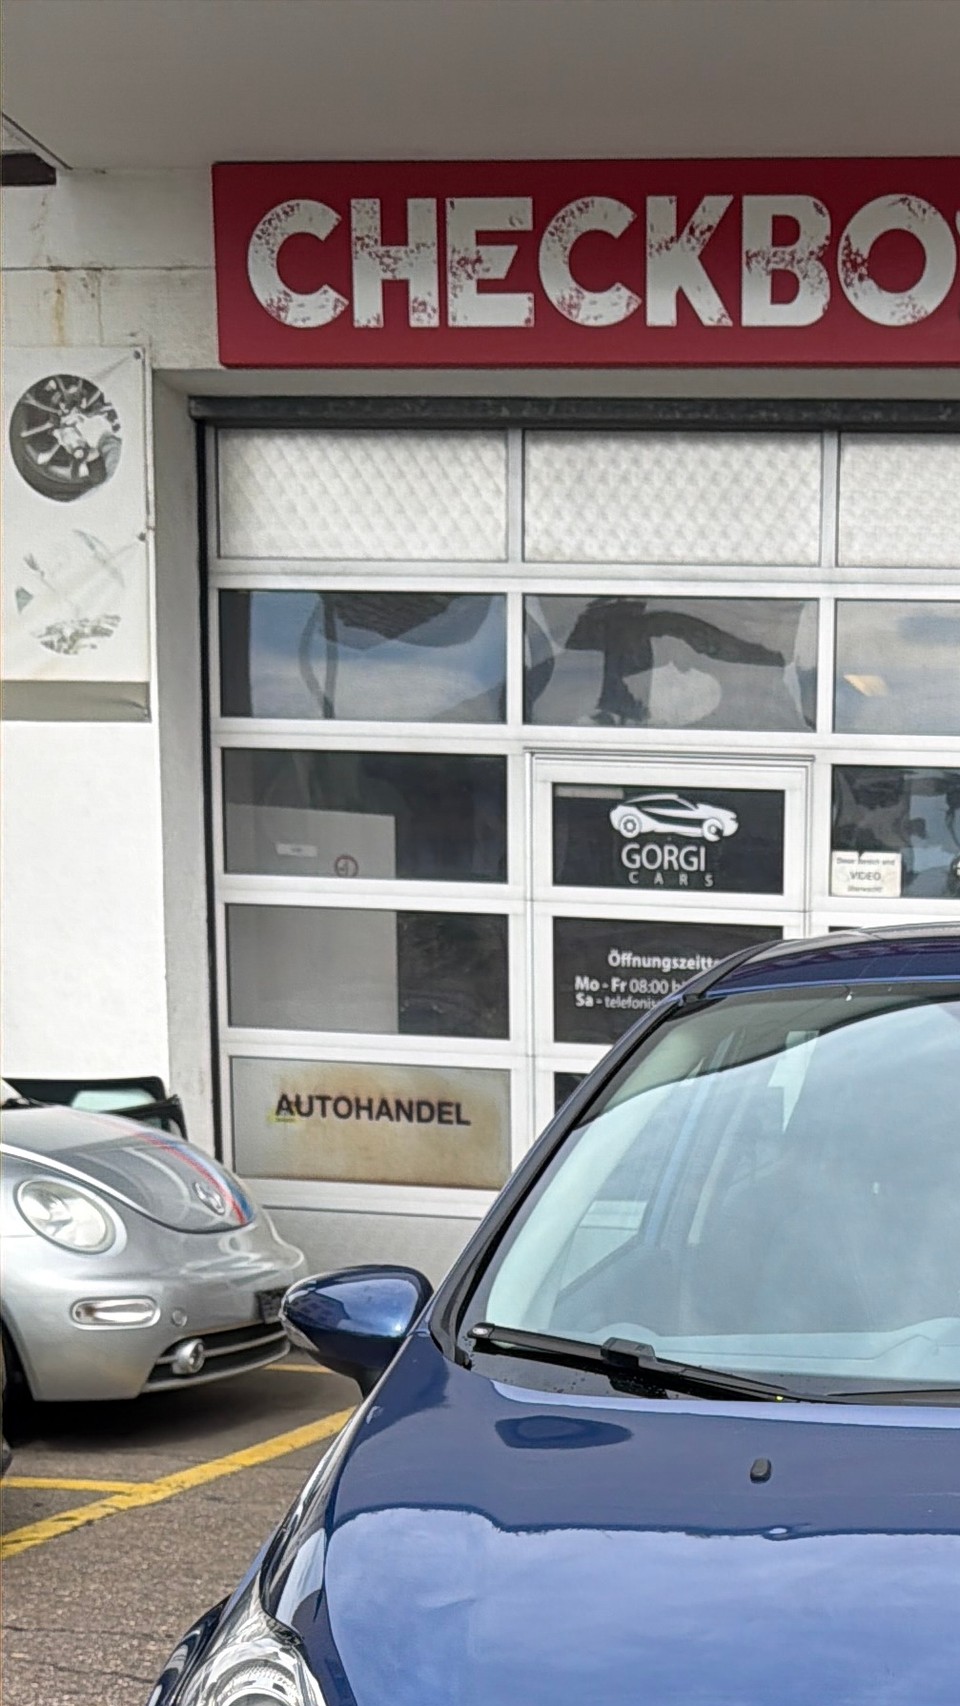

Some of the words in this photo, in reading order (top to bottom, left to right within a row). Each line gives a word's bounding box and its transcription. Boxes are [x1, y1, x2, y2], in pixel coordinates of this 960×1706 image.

[621, 843, 706, 872] GORGI
[628, 871, 714, 888] CARS
[574, 975, 600, 992] Mo
[611, 977, 627, 993] Fr
[629, 978, 668, 995] 08:00
[575, 992, 594, 1007] Sa
[604, 995, 658, 1010] telefonis
[275, 1093, 472, 1126] AUTOHANDEL
